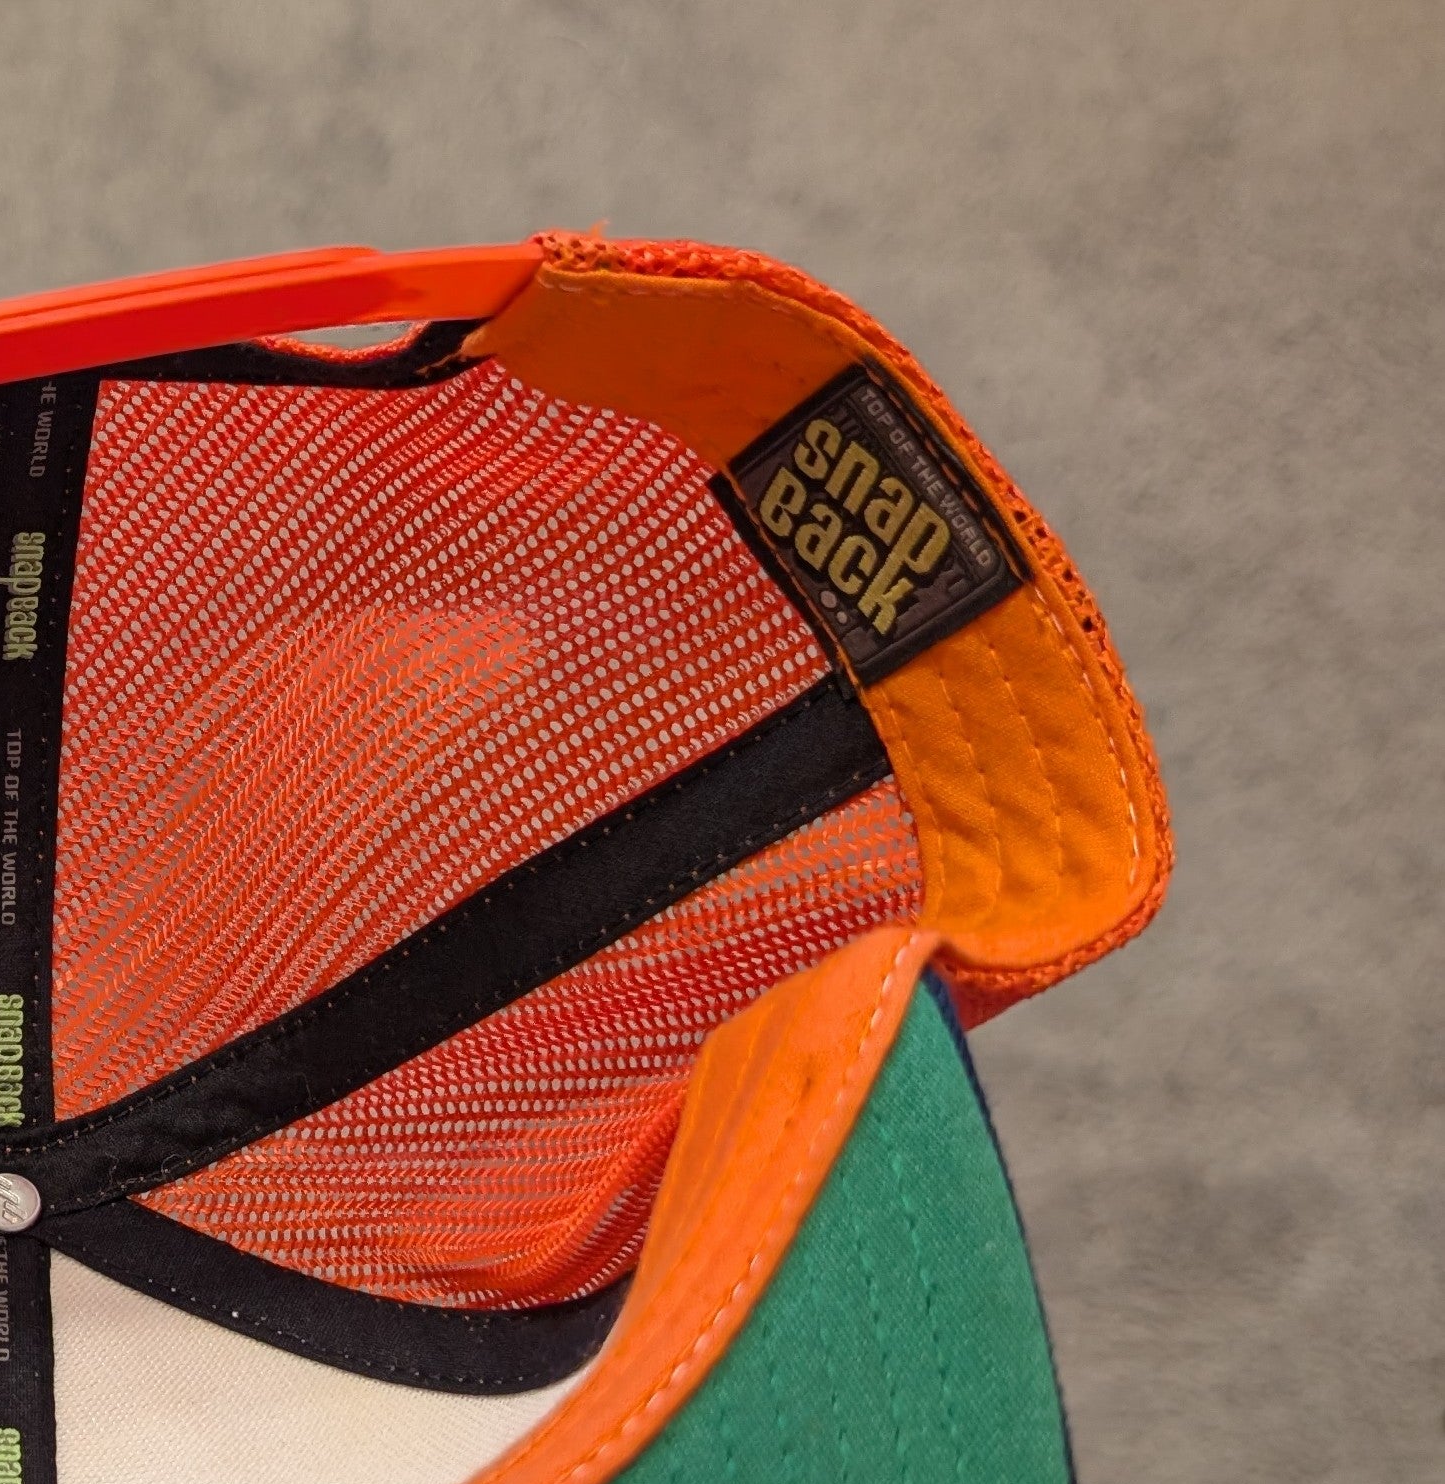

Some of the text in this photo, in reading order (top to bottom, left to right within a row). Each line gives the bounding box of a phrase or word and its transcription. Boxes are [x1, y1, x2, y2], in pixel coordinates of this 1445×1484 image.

[29, 381, 57, 478] HE WORLD
[794, 419, 951, 575] snap
[860, 388, 992, 567] TOP OF THE WORLD
[1, 728, 22, 926] TOP OF THE WORLD
